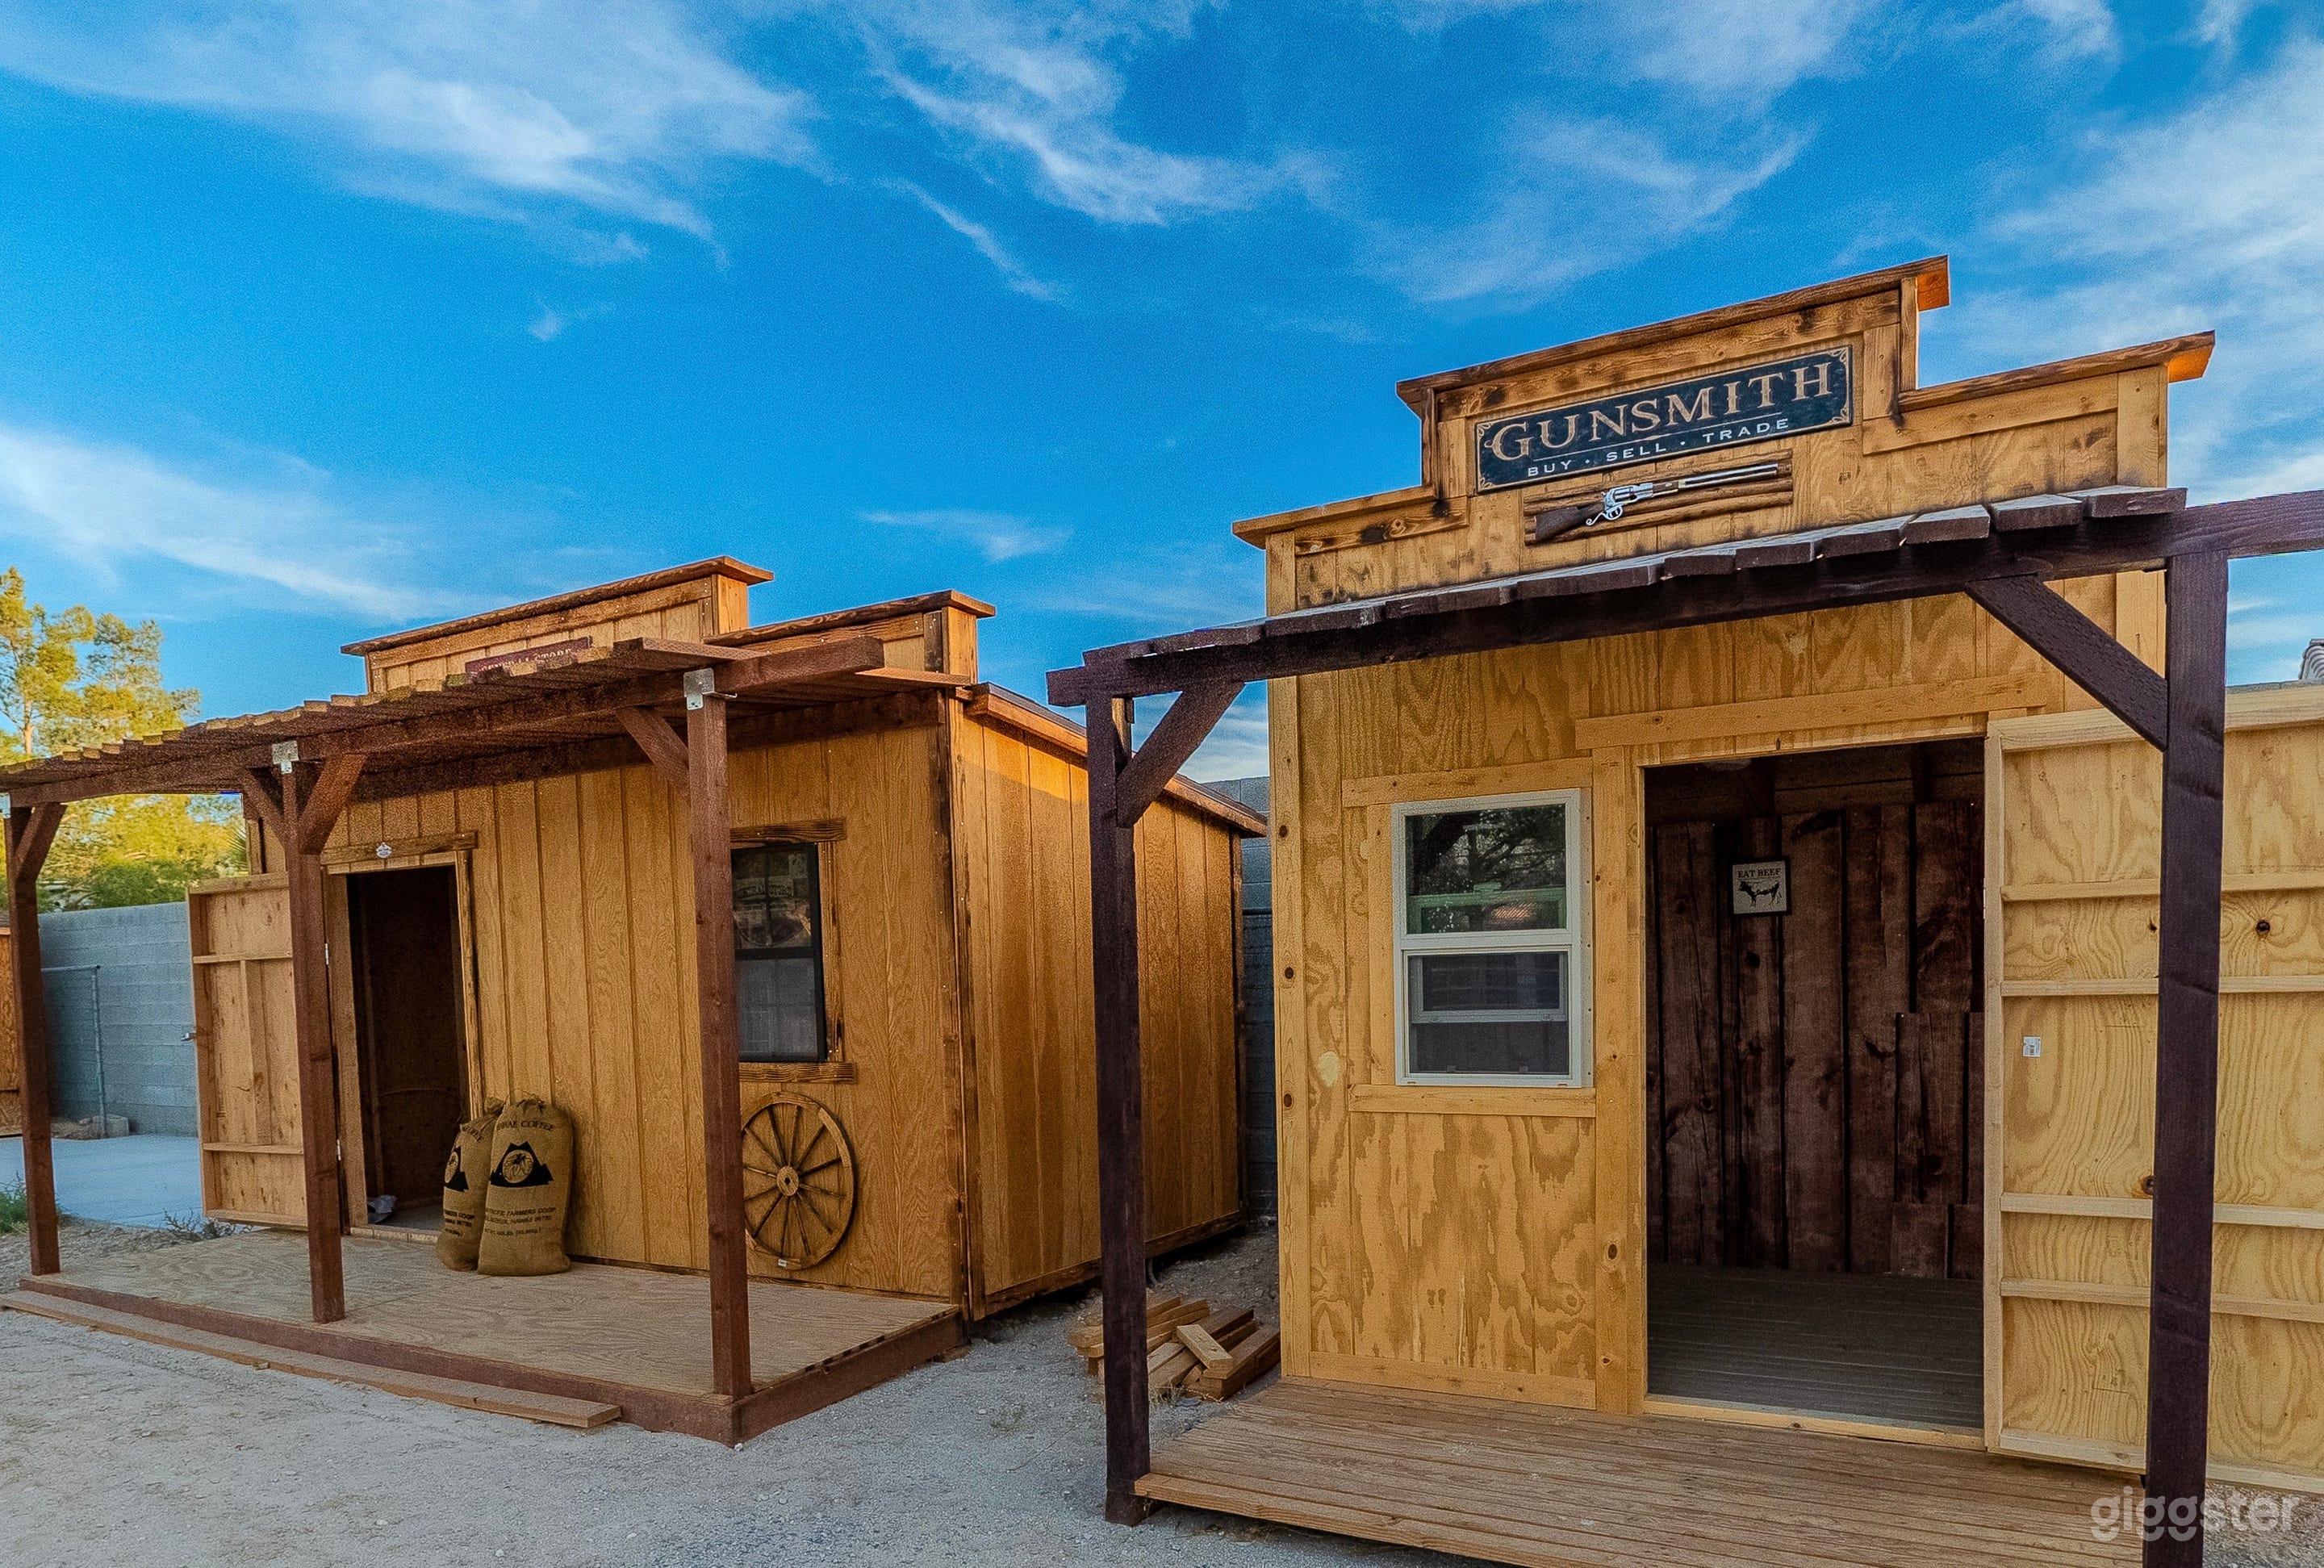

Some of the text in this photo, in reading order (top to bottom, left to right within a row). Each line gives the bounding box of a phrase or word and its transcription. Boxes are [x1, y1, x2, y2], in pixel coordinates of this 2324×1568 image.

[1484, 361, 1833, 462] GUNSMITH
[1528, 418, 1790, 477] BUY SELL TRADE
[1737, 868, 1781, 878] EAT BEEF
[520, 1120, 556, 1132] COFFEE
